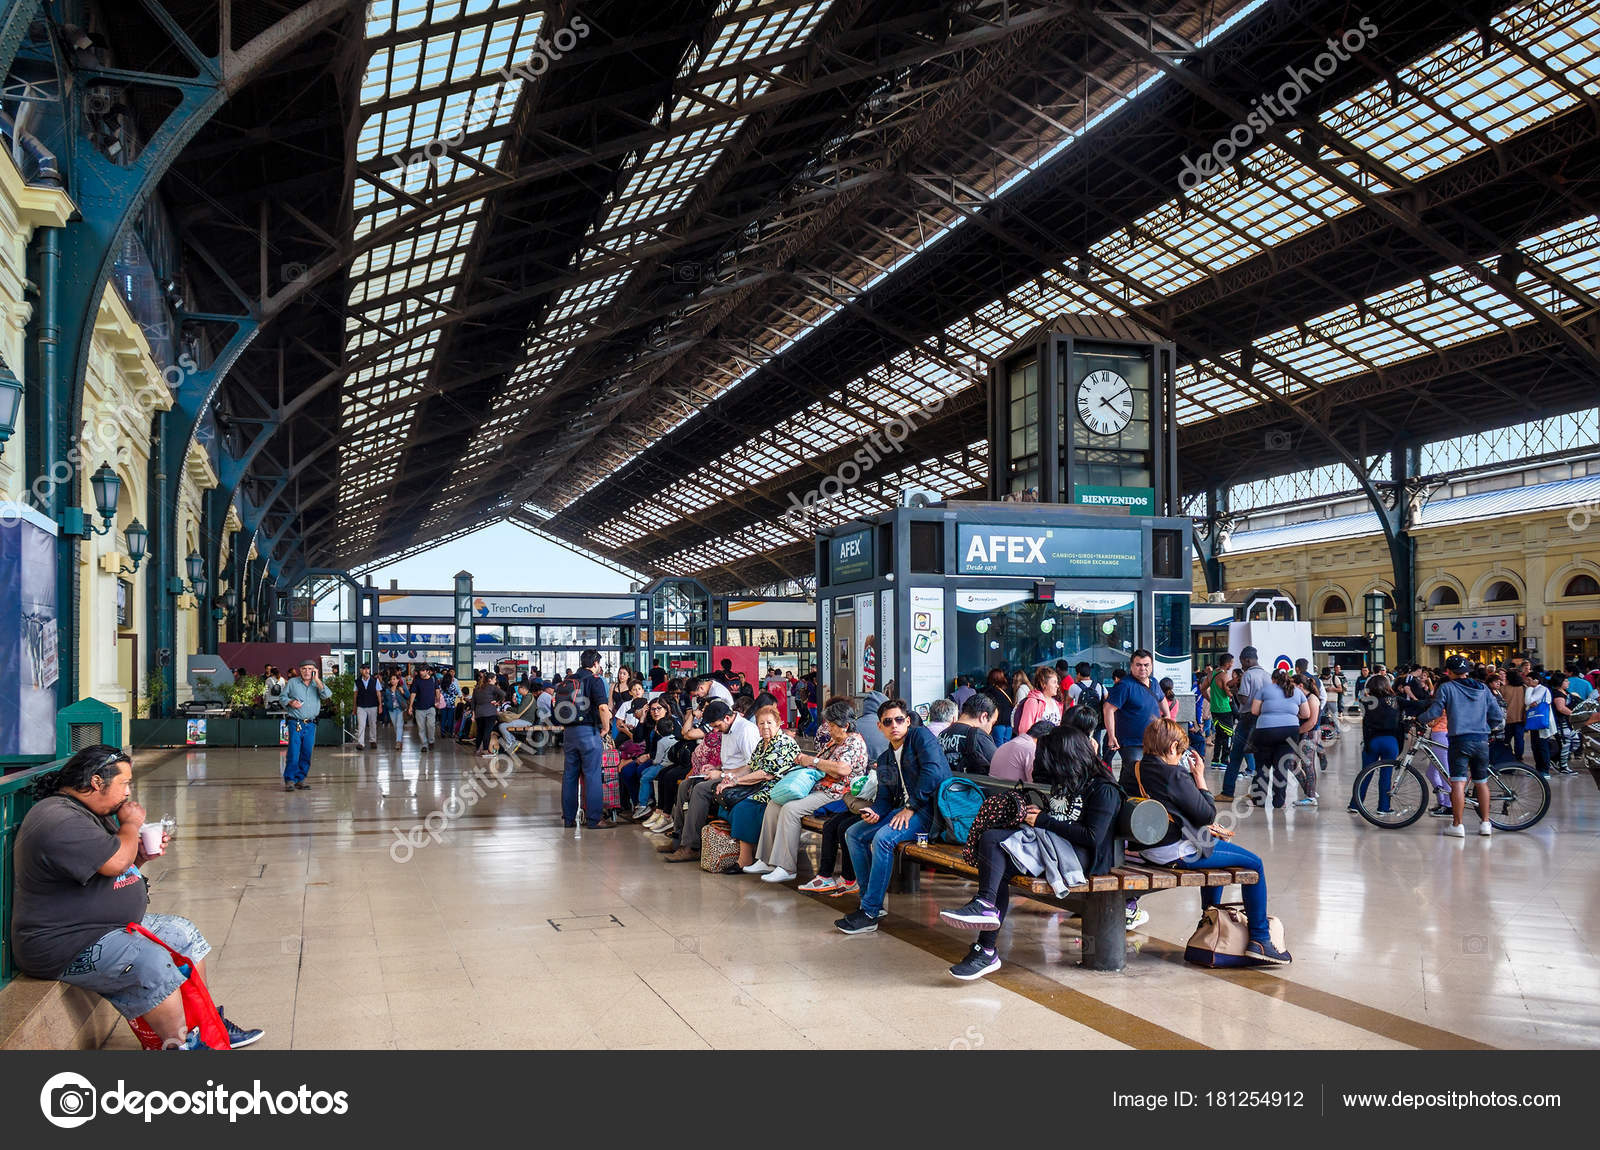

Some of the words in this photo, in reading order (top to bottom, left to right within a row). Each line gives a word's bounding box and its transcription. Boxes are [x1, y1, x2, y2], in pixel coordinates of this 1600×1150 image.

[1081, 494, 1148, 506] BIENVENIDOS
[840, 539, 861, 559] AFEX
[965, 534, 1047, 564] AFEX
[490, 603, 545, 613] TrenCentral
